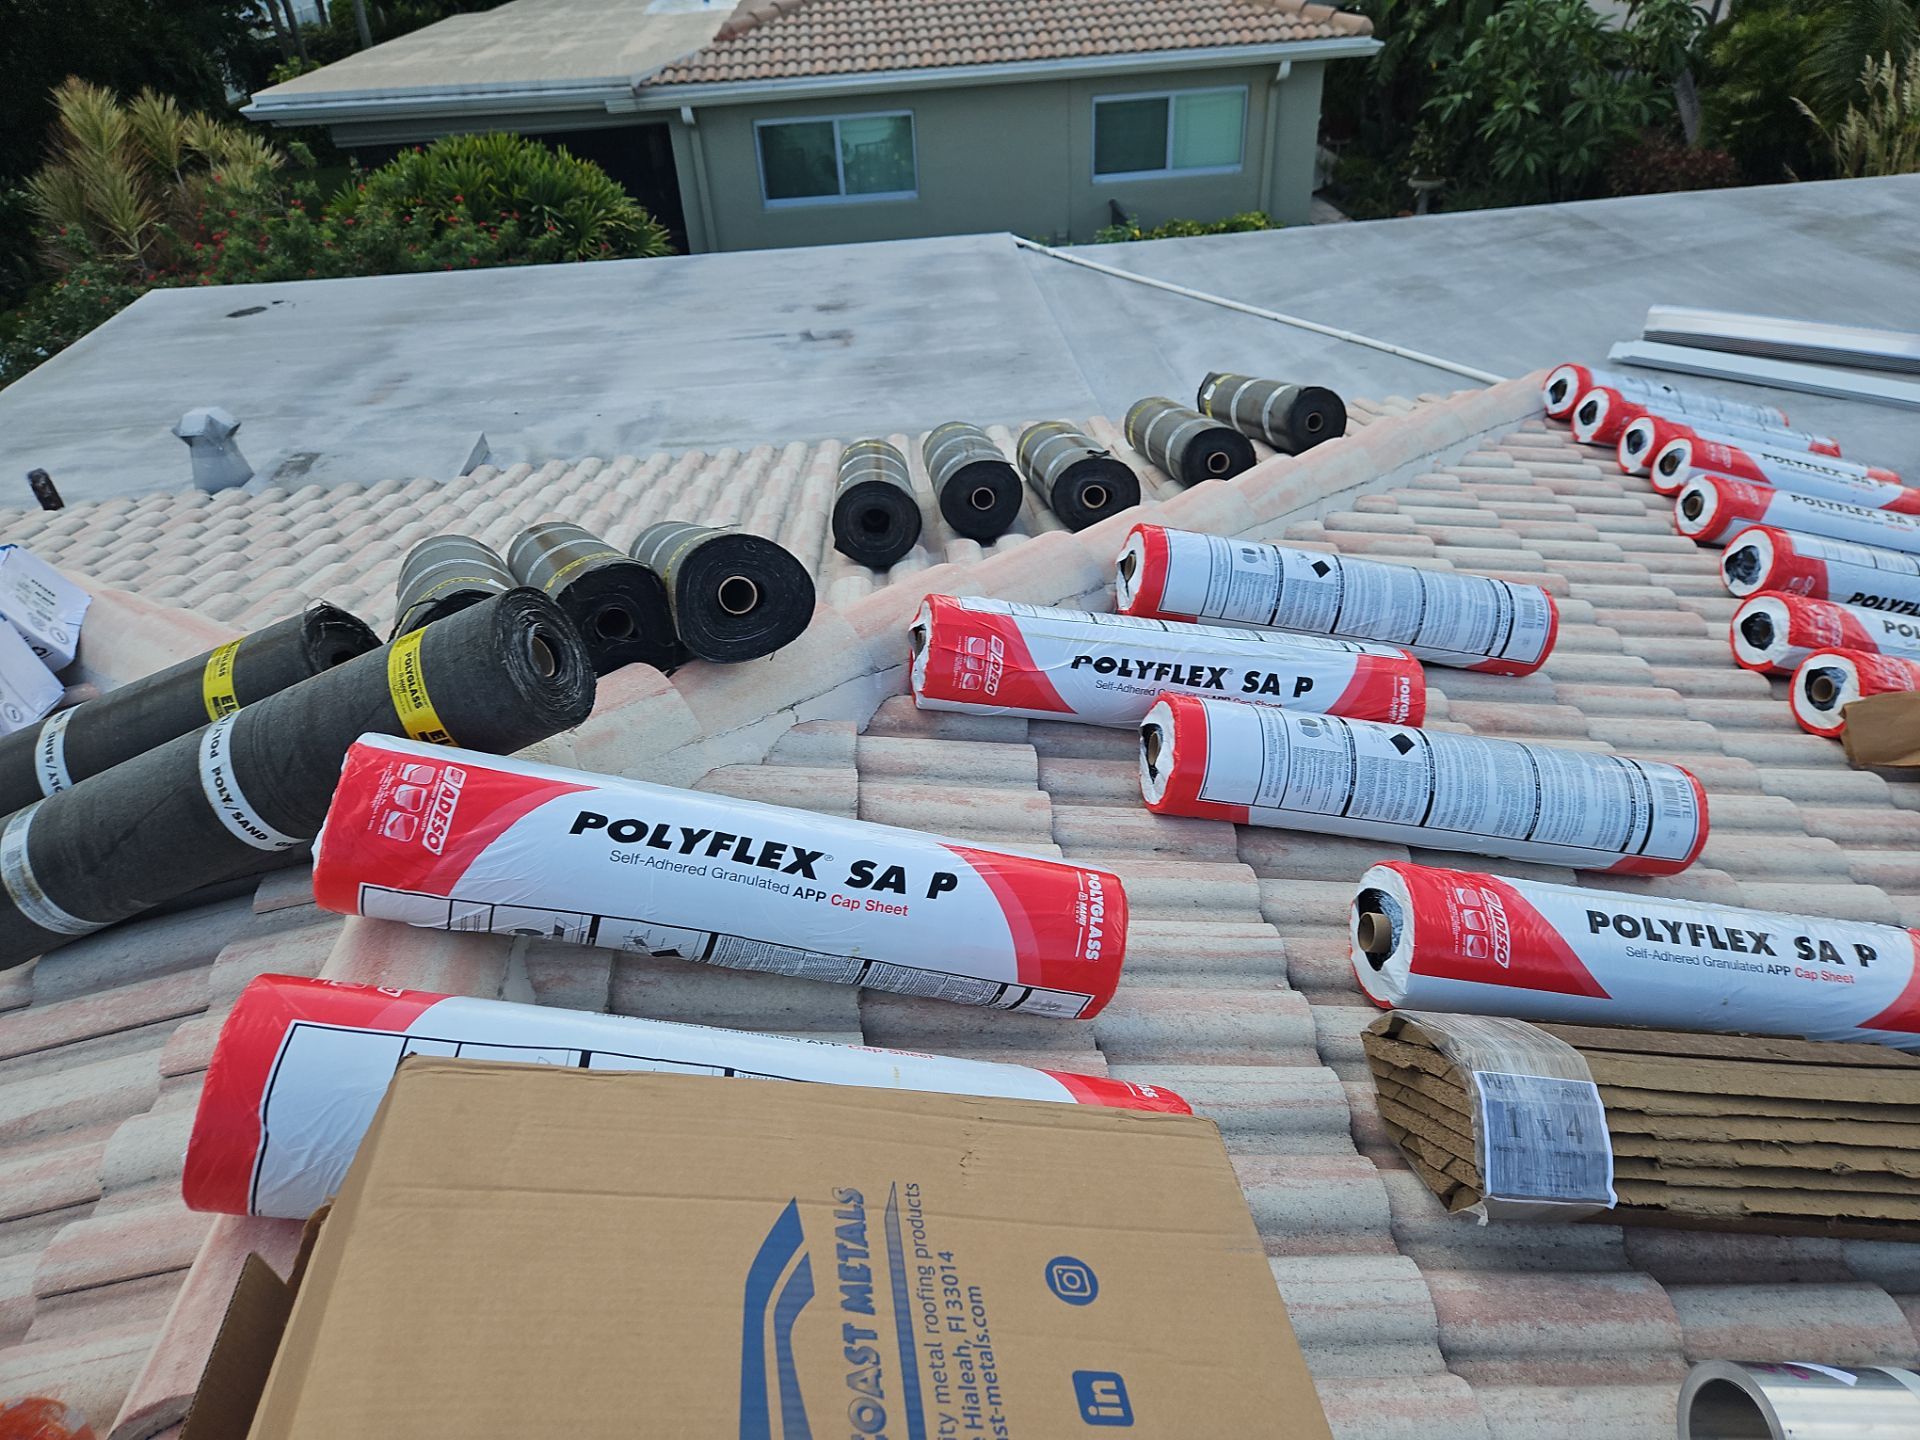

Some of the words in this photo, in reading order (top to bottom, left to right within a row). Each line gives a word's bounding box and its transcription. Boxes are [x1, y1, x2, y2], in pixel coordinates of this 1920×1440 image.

[1071, 655, 1228, 690] POLYFLEX
[1241, 671, 1280, 696] SA
[1293, 676, 1313, 698] P
[1095, 680, 1156, 697] Self-Adhered
[211, 766, 269, 841] POLY/SAND
[426, 783, 457, 850] ADESO
[1676, 779, 1693, 819] WHITE
[569, 810, 825, 881] POLYFLEX
[844, 859, 907, 895] SA
[926, 871, 958, 899] P
[609, 849, 707, 876] Self-Adhered
[711, 867, 790, 895] Granulated
[792, 886, 827, 903] APP
[830, 893, 861, 912] Cap
[864, 899, 909, 917] Sheet
[1085, 872, 1104, 960] POLYGLASS
[1490, 904, 1509, 964] ADESO
[1586, 909, 1778, 957] POLYFLEX
[1793, 935, 1846, 966] SA
[1852, 943, 1878, 967] P
[1625, 946, 1700, 966] Self-Adhered
[1703, 955, 1764, 974] Granulated
[1767, 964, 1791, 977] APP
[1795, 966, 1819, 982] Cap
[1821, 970, 1855, 984] Sheet
[832, 1187, 875, 1316] METALS
[905, 1183, 934, 1259] products
[916, 1265, 940, 1334] roofing
[938, 1251, 963, 1311] 33014
[842, 1322, 889, 1440] OAST
[923, 1342, 951, 1404] metal
[952, 1339, 984, 1430] Hialeah,
